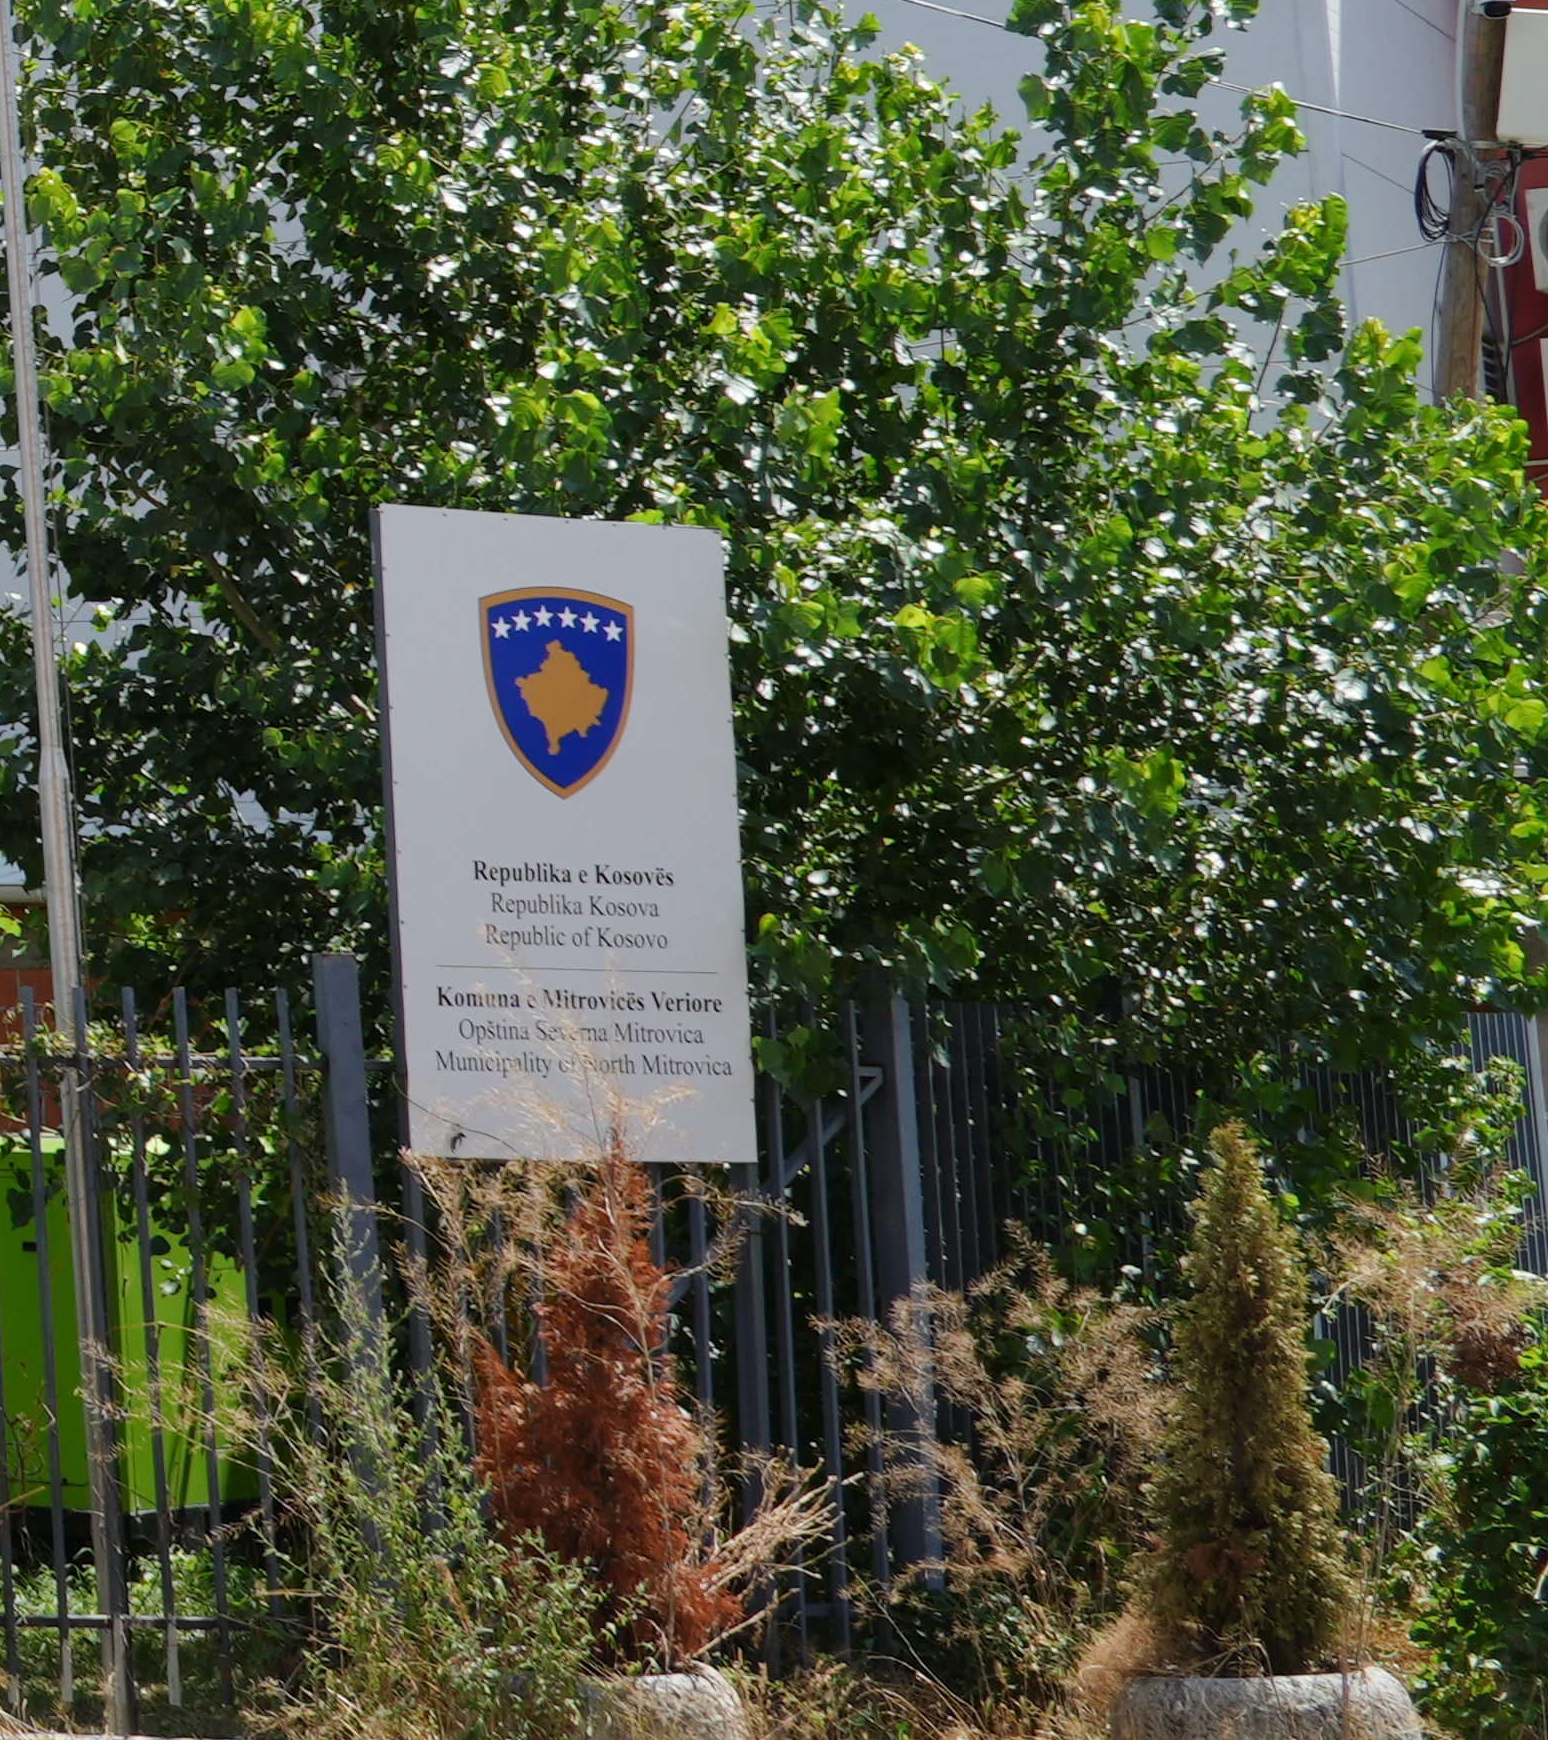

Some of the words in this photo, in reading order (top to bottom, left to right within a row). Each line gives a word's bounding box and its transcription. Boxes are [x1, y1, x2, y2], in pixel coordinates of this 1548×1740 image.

[473, 860, 572, 887] Republika
[578, 869, 588, 884] e
[594, 864, 675, 886] Kosovës
[491, 892, 583, 919] Republika
[589, 895, 660, 917] Kosova
[485, 923, 566, 951] Republic
[572, 926, 593, 947] of
[597, 927, 668, 949] Kosovo
[436, 986, 521, 1008] Komuna
[527, 994, 537, 1009] e
[650, 991, 723, 1012] Veriore
[459, 1018, 530, 1045] Opština
[614, 1022, 705, 1044] Mitrovica
[435, 1049, 551, 1078] Municipality
[642, 1054, 734, 1076] Mitrovica
